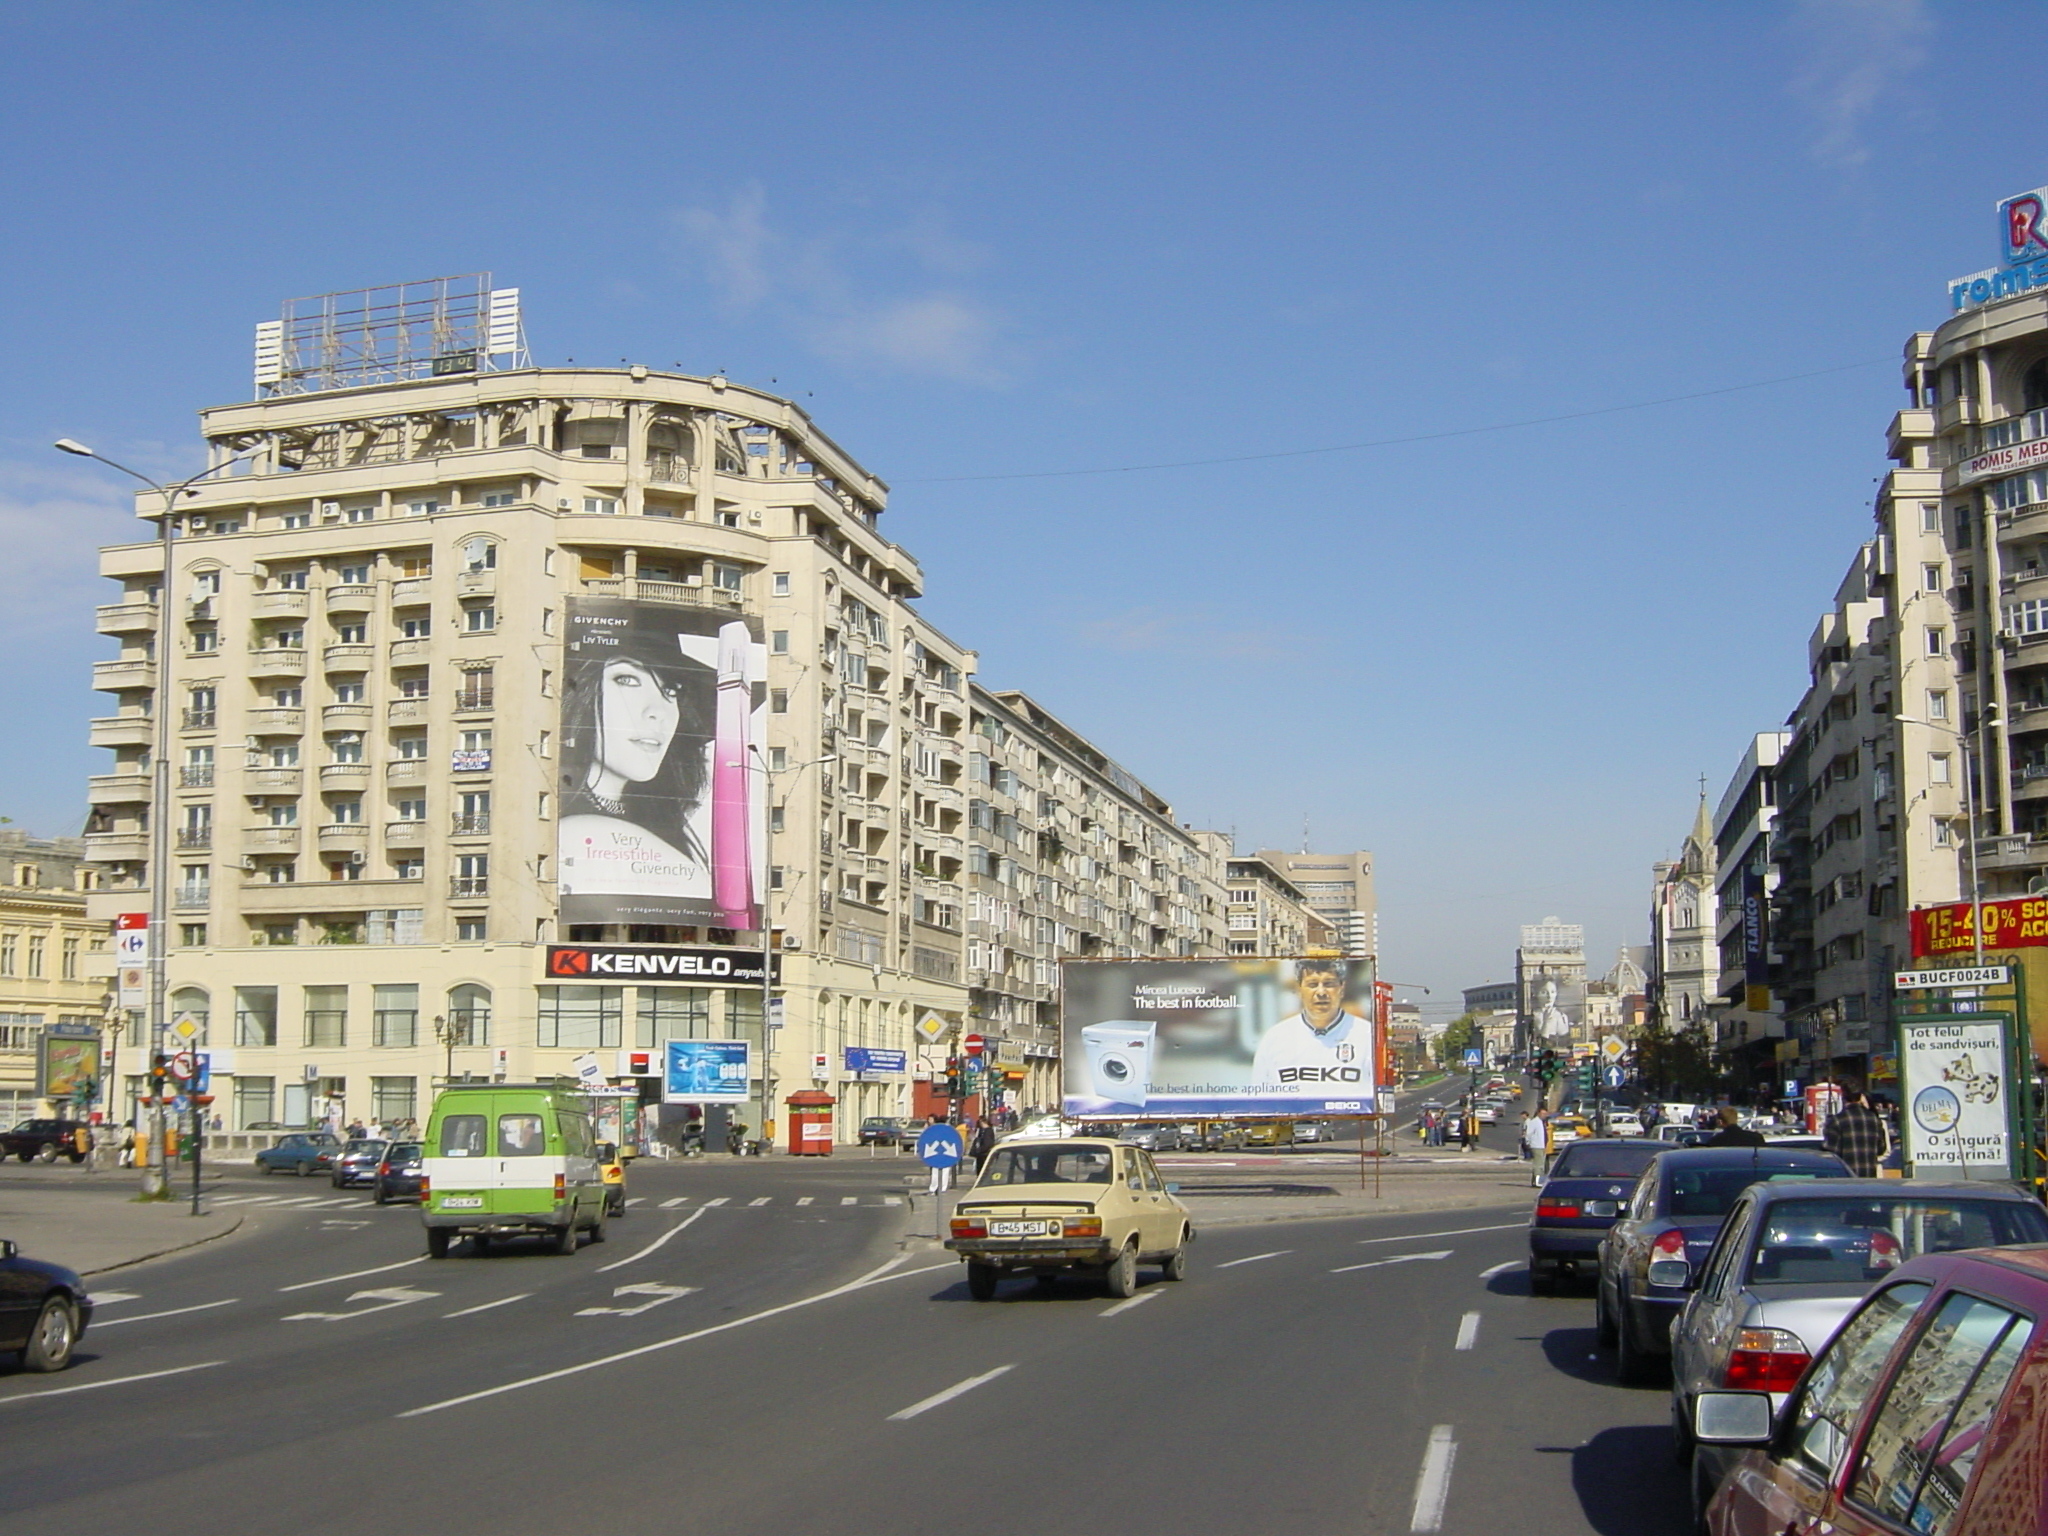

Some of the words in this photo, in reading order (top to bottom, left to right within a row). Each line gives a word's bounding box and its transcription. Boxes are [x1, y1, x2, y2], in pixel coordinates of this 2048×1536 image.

[1971, 450, 2013, 473] ROMIS
[574, 616, 629, 626] GIVENCHY
[611, 832, 642, 849] Very
[631, 861, 696, 881] Givenchy
[2021, 901, 2048, 918] SC
[1746, 897, 1759, 953] FLANCO
[2020, 920, 2048, 938] AC
[591, 953, 731, 976] KENVELO
[1919, 969, 2000, 984] BUCF0024B
[1133, 996, 1155, 1009] The
[1156, 996, 1179, 1009] best
[1181, 996, 1192, 1009] in
[1910, 1027, 1930, 1037] Tot
[1934, 1026, 1963, 1037] felul
[1910, 1040, 1926, 1050] de
[1278, 1066, 1361, 1083] BEKO
[1143, 1083, 1164, 1094] The
[1167, 1083, 1190, 1094] best
[1193, 1083, 1204, 1094] in
[1206, 1083, 1238, 1094] home
[1241, 1083, 1300, 1097] appliances
[1325, 1101, 1361, 1110] BEKO
[1927, 1135, 1939, 1146] O
[1944, 1133, 2001, 1149] singură
[1916, 1149, 2001, 1162] margarină!
[1022, 1222, 1042, 1233] MST
